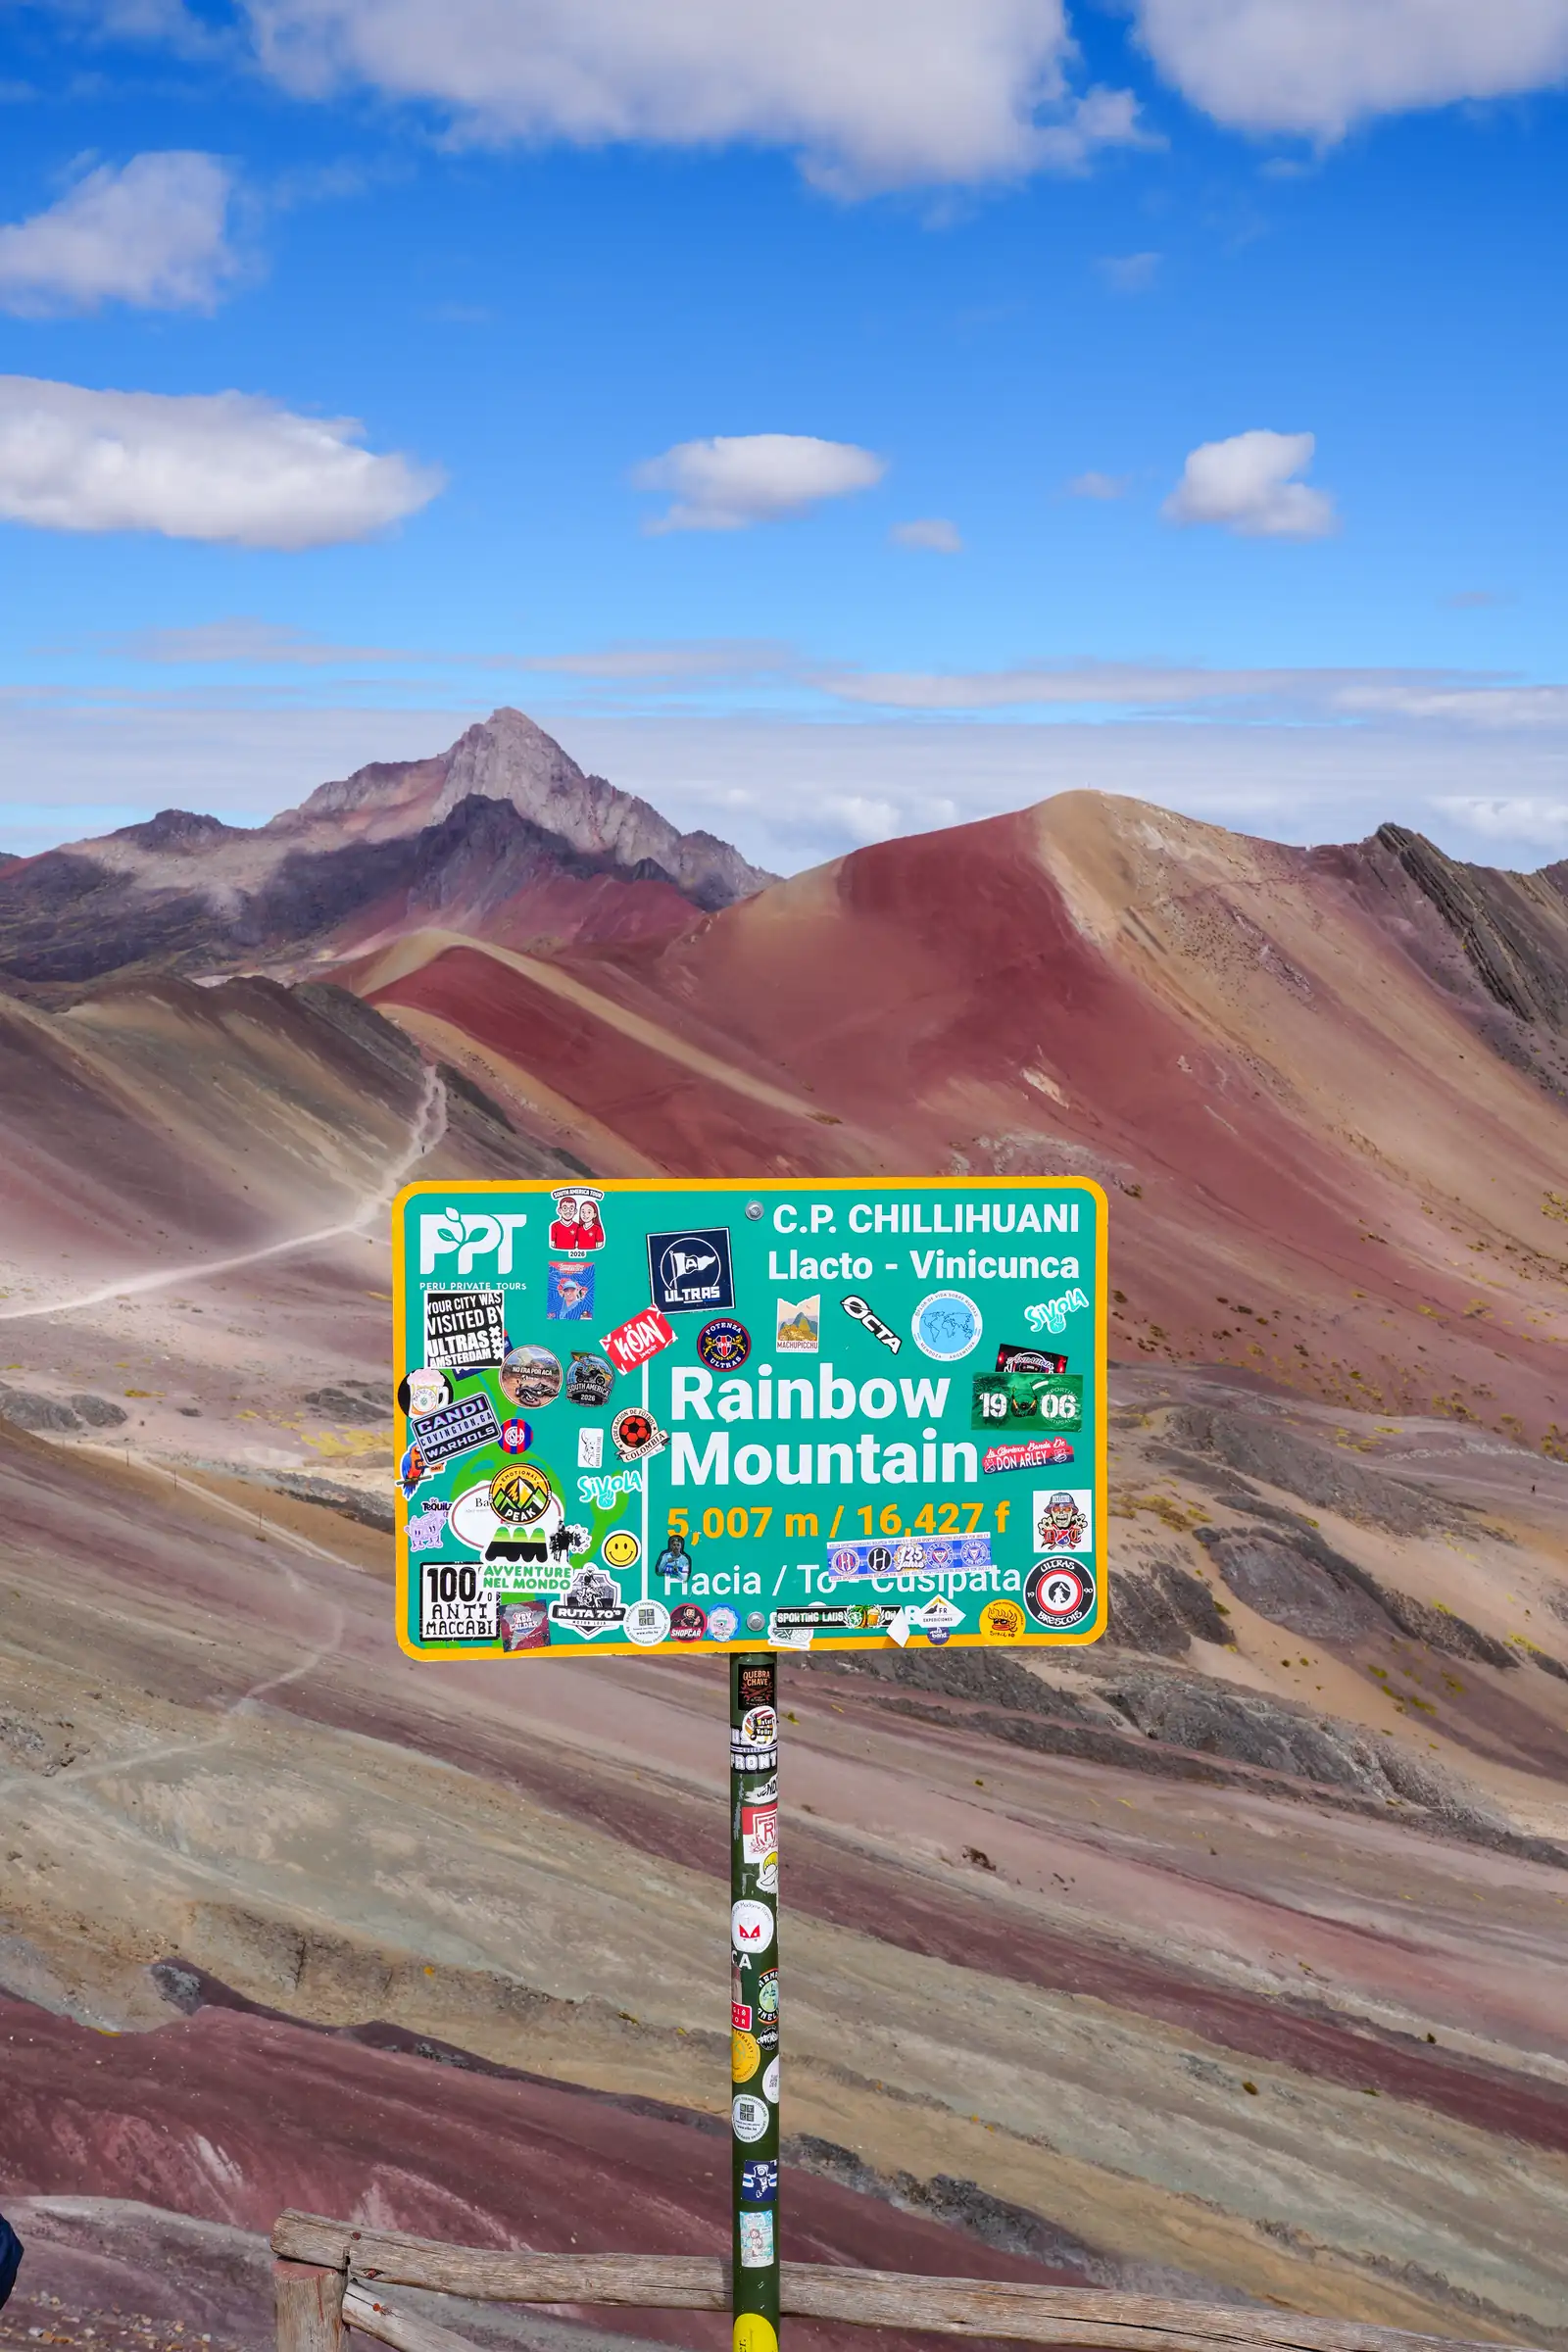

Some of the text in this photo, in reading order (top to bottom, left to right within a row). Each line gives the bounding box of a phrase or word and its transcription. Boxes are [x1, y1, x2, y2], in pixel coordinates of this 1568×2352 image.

[773, 1203, 1079, 1234] C.P. CHILLIHUANI
[420, 1214, 527, 1274] PPT
[768, 1249, 873, 1280] Llacto
[909, 1249, 1080, 1279] Vinicunca
[419, 1282, 527, 1291] PERU PRIVATE TOURS
[664, 1286, 720, 1302] ULTRAS
[427, 1293, 502, 1315] YOUR CITY WAS
[427, 1305, 504, 1336] VISITED BY
[706, 1322, 742, 1336] POTENZA
[842, 1295, 902, 1354] OCTA
[427, 1329, 490, 1357] ULTRAS
[777, 1341, 818, 1349] MACHUPICCHU
[920, 1342, 975, 1360] MENDOZA ARGENTINA
[429, 1348, 492, 1368] AMSTERDAM
[710, 1356, 742, 1369] ULTRAS
[568, 1383, 610, 1396] SOUTH AMERICA
[671, 1363, 951, 1421] Rainbow
[979, 1393, 1077, 1419] 19 06
[416, 1399, 485, 1434] CANDI
[426, 1426, 495, 1458] WARHOLS
[625, 1433, 665, 1461] COLOMBIA
[1054, 1439, 1065, 1447] De
[671, 1428, 978, 1486] Mountain
[996, 1449, 1048, 1471] DON ARLEY
[502, 1470, 538, 1482] EMOTIONAL
[505, 1508, 538, 1521] PEAK
[667, 1507, 773, 1546] 5,007
[785, 1511, 818, 1537] m
[829, 1505, 845, 1539] /
[858, 1502, 984, 1540] 16,427
[995, 1500, 1010, 1534] f
[898, 1544, 923, 1562] 125
[483, 1565, 571, 1579] AVVENTURE
[1040, 1559, 1075, 1573] ULTRAS
[483, 1578, 571, 1590] NEL MONDO
[772, 1565, 787, 1596] /
[797, 1565, 833, 1593] To
[432, 1603, 487, 1620] ANTI
[558, 1607, 595, 1618] RUTA
[777, 1612, 819, 1623] SPORTING
[425, 1620, 494, 1636] MACCABI
[671, 1628, 702, 1637] SHOPCAR
[743, 1670, 770, 1681] QUEBRA
[747, 1678, 768, 1687] CHAVE
